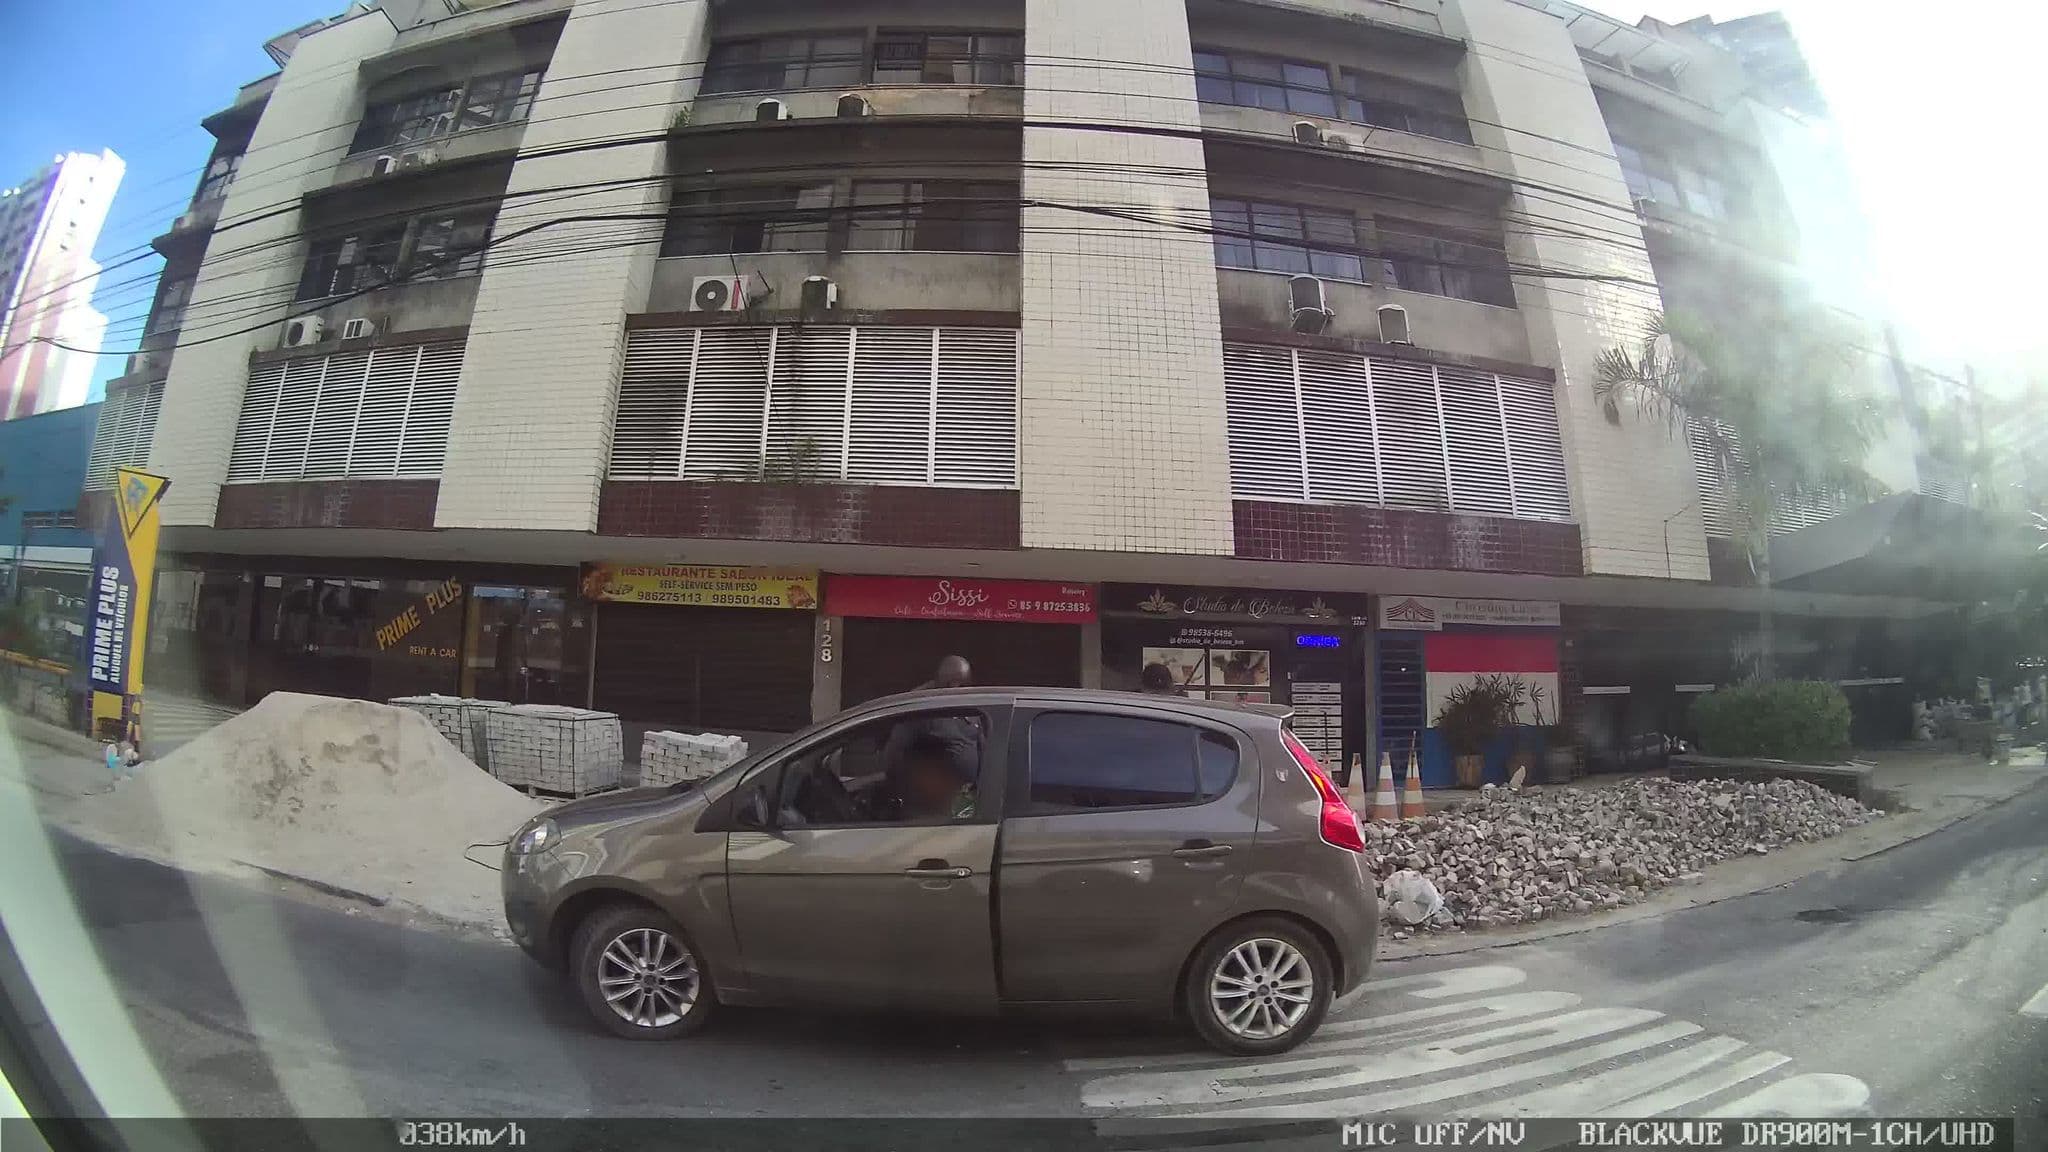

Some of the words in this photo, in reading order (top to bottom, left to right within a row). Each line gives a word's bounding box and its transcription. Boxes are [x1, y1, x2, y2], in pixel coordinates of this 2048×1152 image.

[621, 566, 717, 579] RESTAURANTE
[97, 566, 120, 615] PLUS
[735, 582, 758, 592] PESO
[928, 580, 989, 606] Sissi
[376, 605, 421, 650] PRIME
[424, 576, 463, 615] PLUS
[1019, 600, 1032, 611] 85
[91, 617, 114, 682] PRIME
[409, 645, 427, 657] RENT
[430, 647, 437, 657] A
[439, 647, 457, 658] CAR
